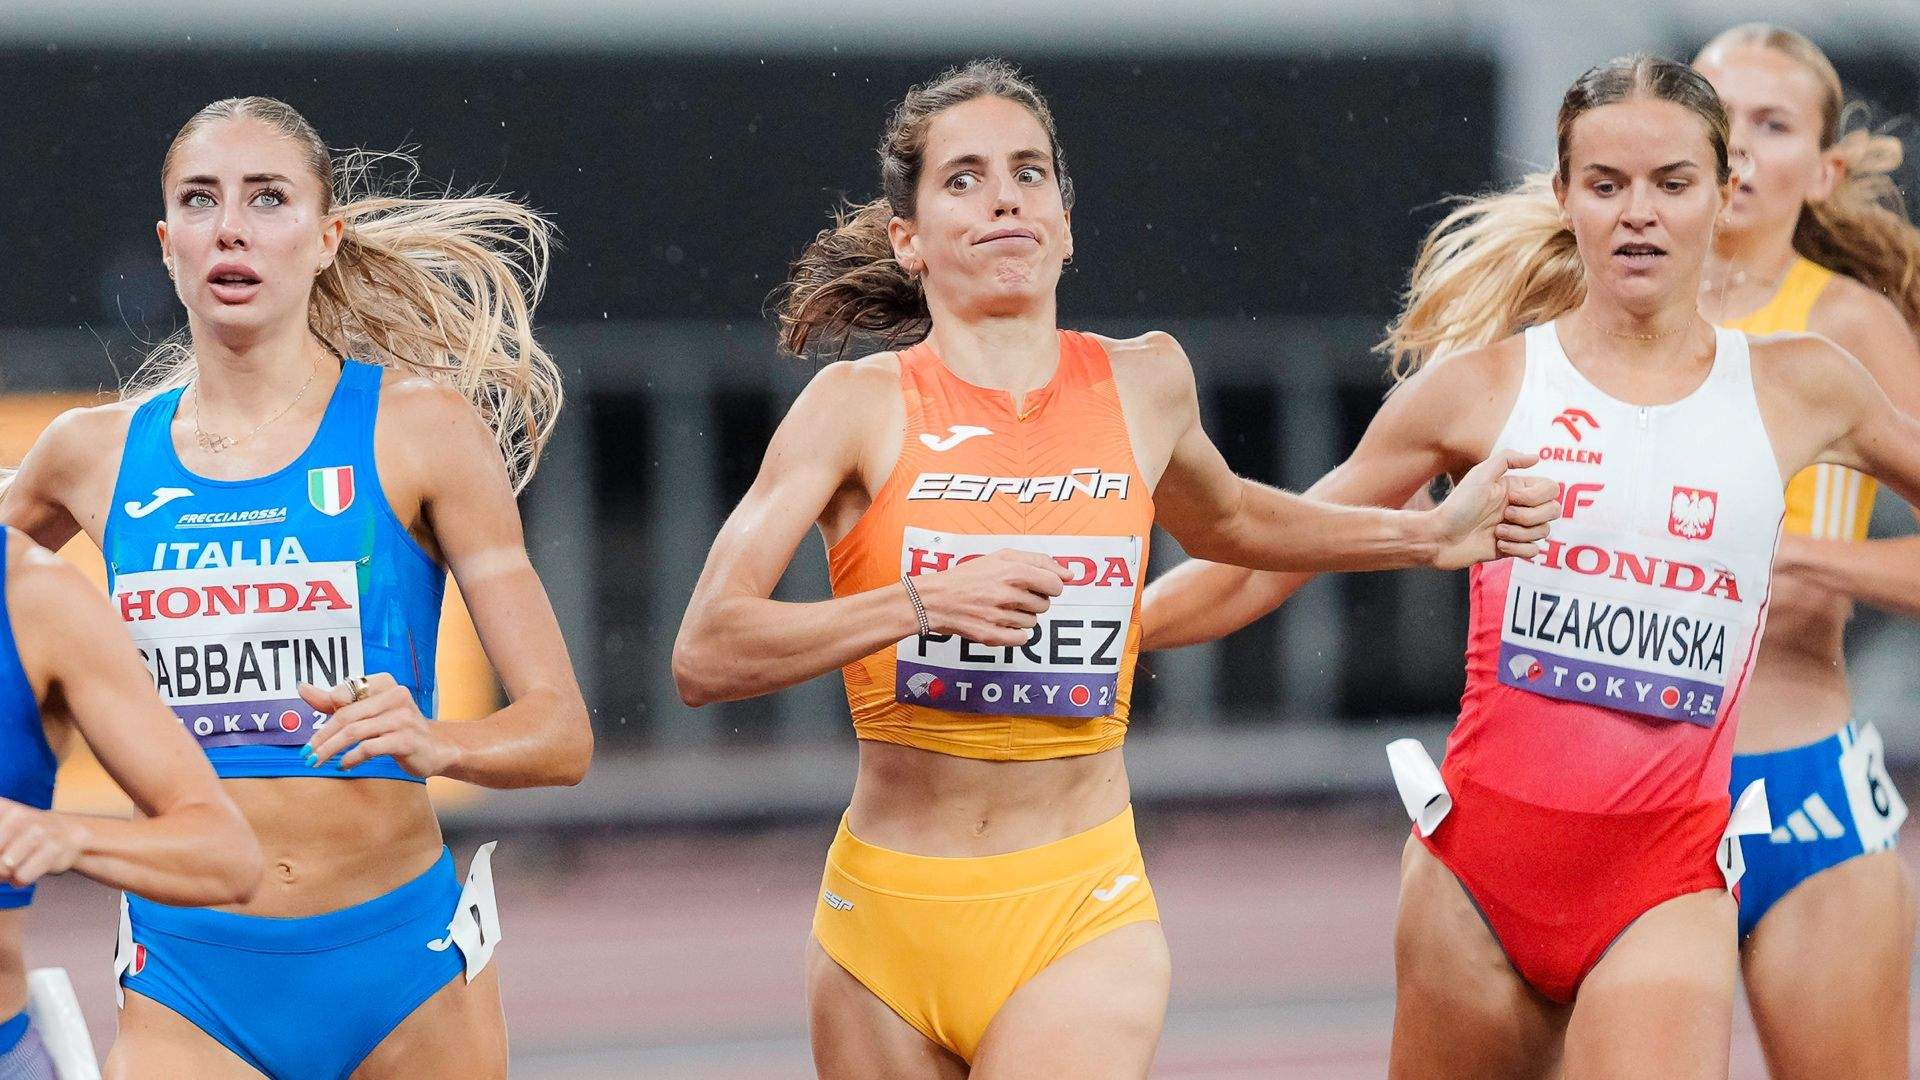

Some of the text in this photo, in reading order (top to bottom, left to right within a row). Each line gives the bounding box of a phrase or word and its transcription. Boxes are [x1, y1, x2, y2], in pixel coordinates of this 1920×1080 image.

[1539, 447, 1603, 465] ORLEN
[906, 467, 1131, 503] ESPAÑA
[178, 507, 287, 524] FRECCIAROSSA
[153, 536, 310, 571] ITALIA
[907, 547, 1134, 587] HDA
[1520, 540, 1743, 602] HONDA
[117, 580, 353, 622] HONDA
[1511, 586, 1726, 674] LIZAKOWSKA
[138, 636, 350, 698] ABBATINI
[177, 709, 302, 736] OKYO
